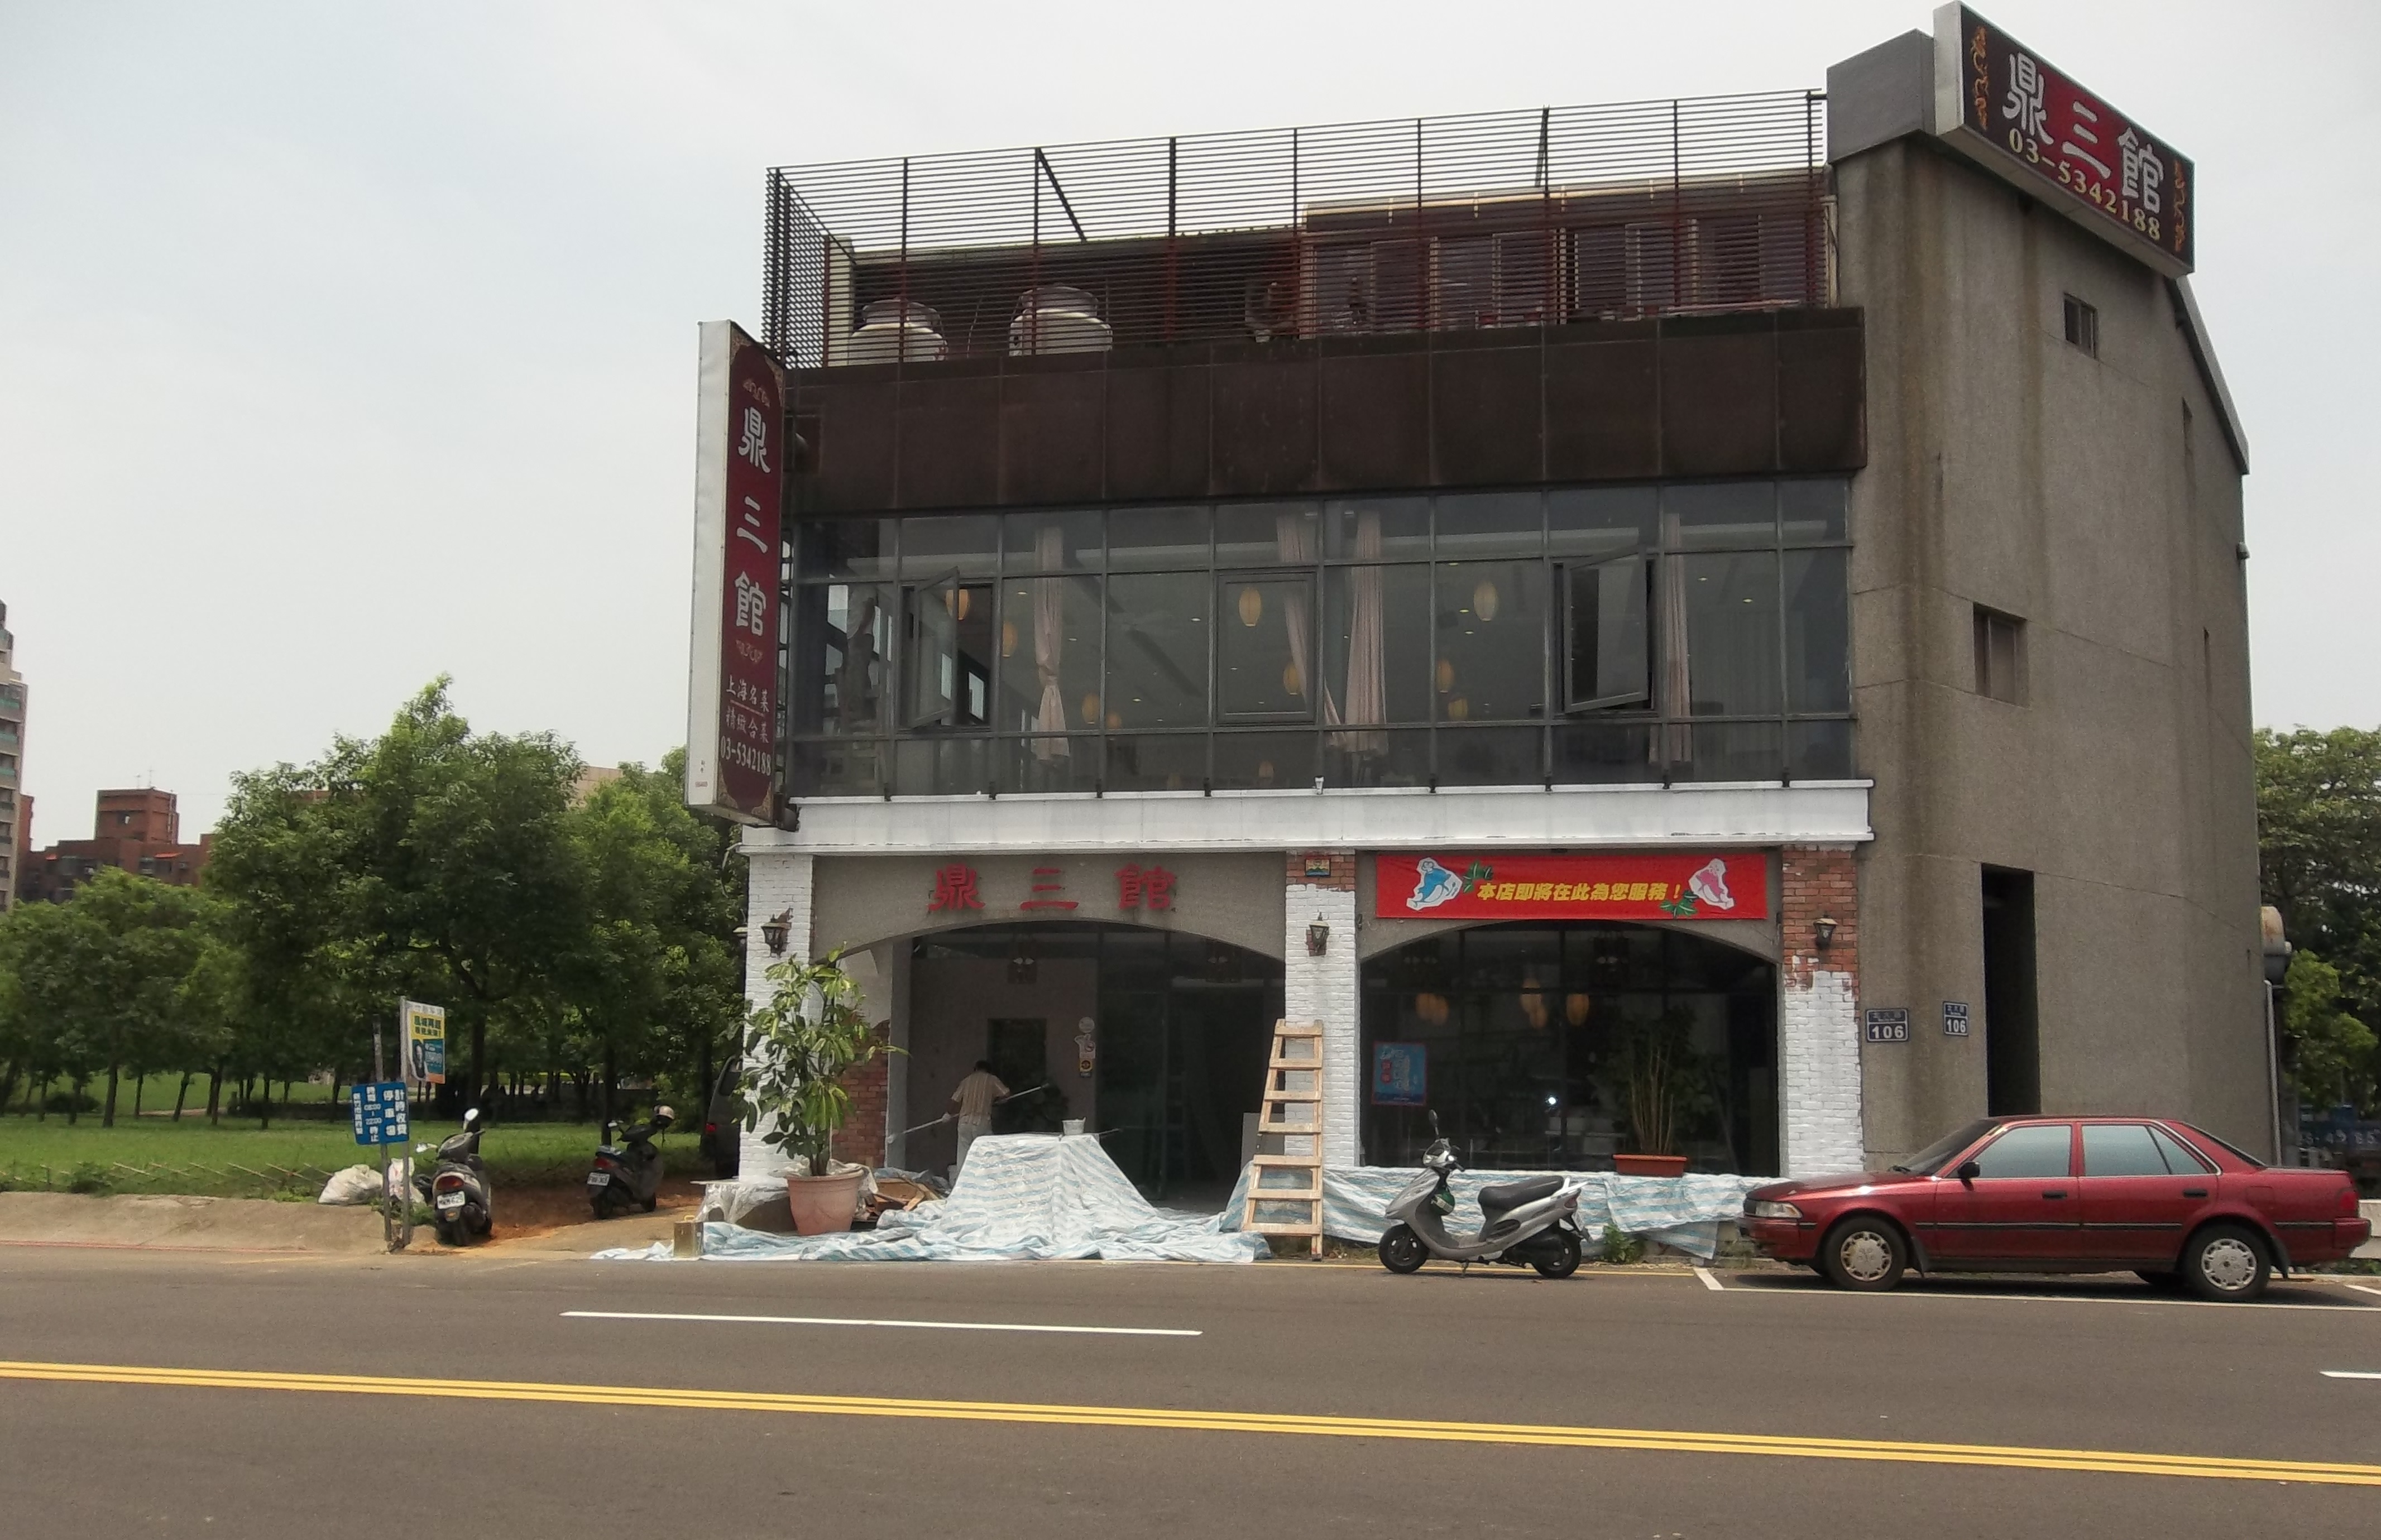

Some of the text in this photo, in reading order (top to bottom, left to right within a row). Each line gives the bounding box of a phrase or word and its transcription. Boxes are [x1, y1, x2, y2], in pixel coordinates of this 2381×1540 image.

[2002, 52, 2164, 214] 鼎三館
[2009, 127, 2160, 241] 03-5342188
[735, 406, 770, 636] 鼎三館
[726, 674, 770, 712] 上海名菜
[721, 735, 772, 776] 03-5342188
[927, 863, 1177, 911] 鼎三館
[1872, 1025, 1904, 1039] 106
[1947, 1018, 1966, 1033] 106
